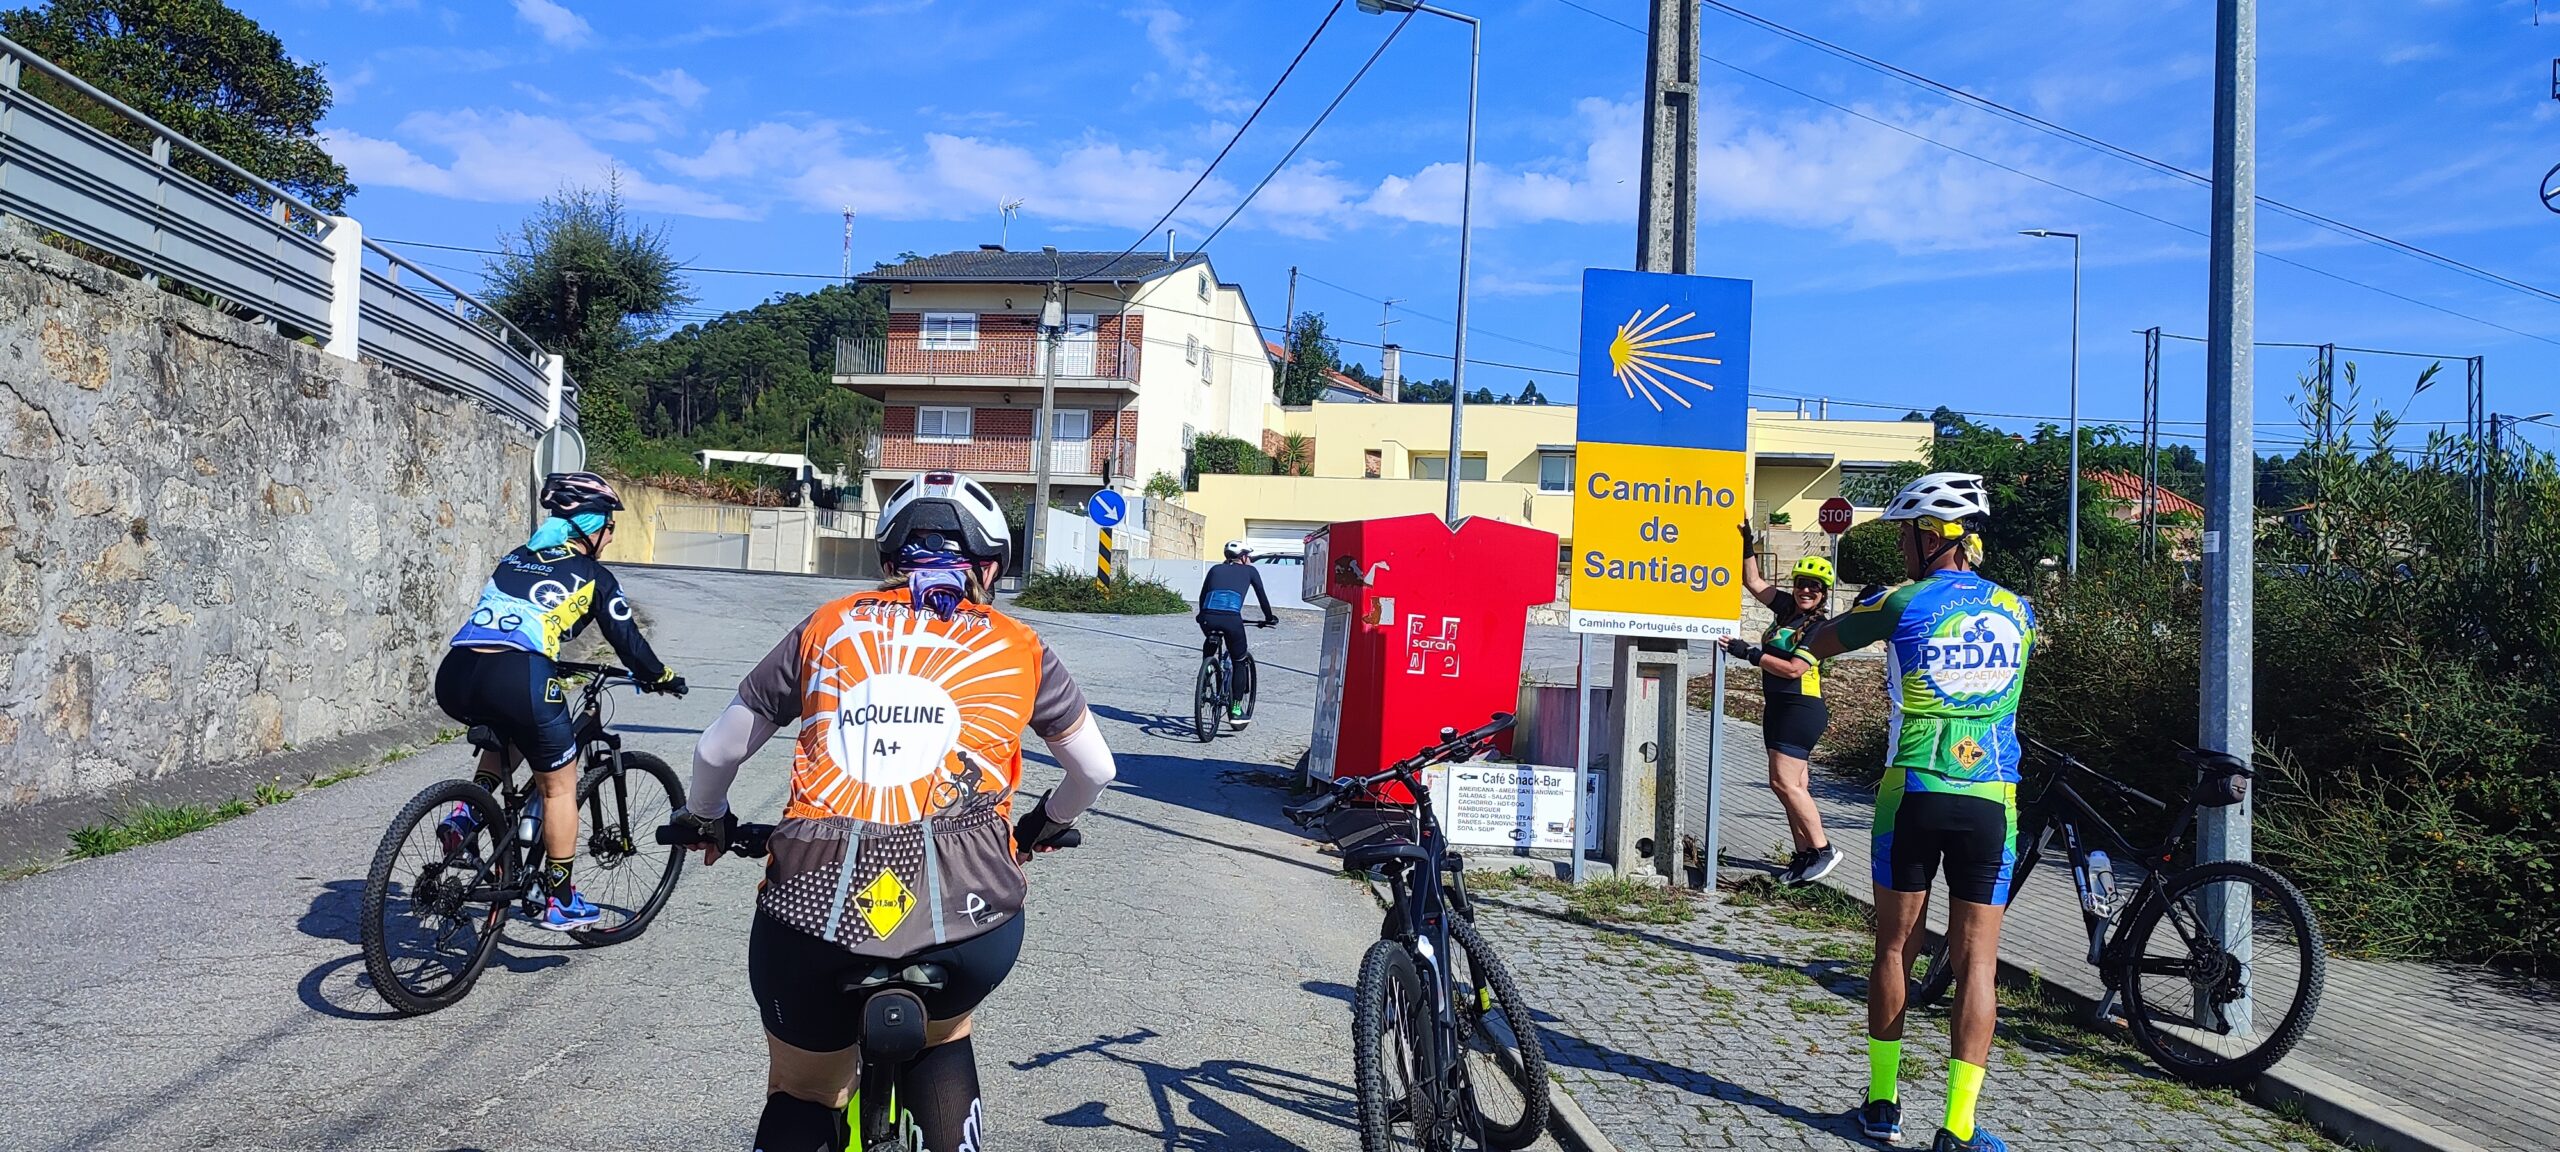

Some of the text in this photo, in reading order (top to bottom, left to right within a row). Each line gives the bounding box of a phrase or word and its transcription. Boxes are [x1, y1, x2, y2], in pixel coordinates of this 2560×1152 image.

[1588, 472, 1735, 508] Caminho
[1820, 509, 1852, 522] STOP
[1640, 516, 1679, 543] de
[516, 562, 554, 573] LAGOS
[1584, 551, 1730, 592] Santiago
[1578, 617, 1731, 635] Caminho Português da Costa
[1412, 639, 1456, 652] sarah
[1919, 642, 2021, 670] PEDAL
[873, 738, 901, 757] A+
[1482, 772, 1562, 787] Café Snack-Bar
[1457, 805, 1501, 813] HAMBURGUER
